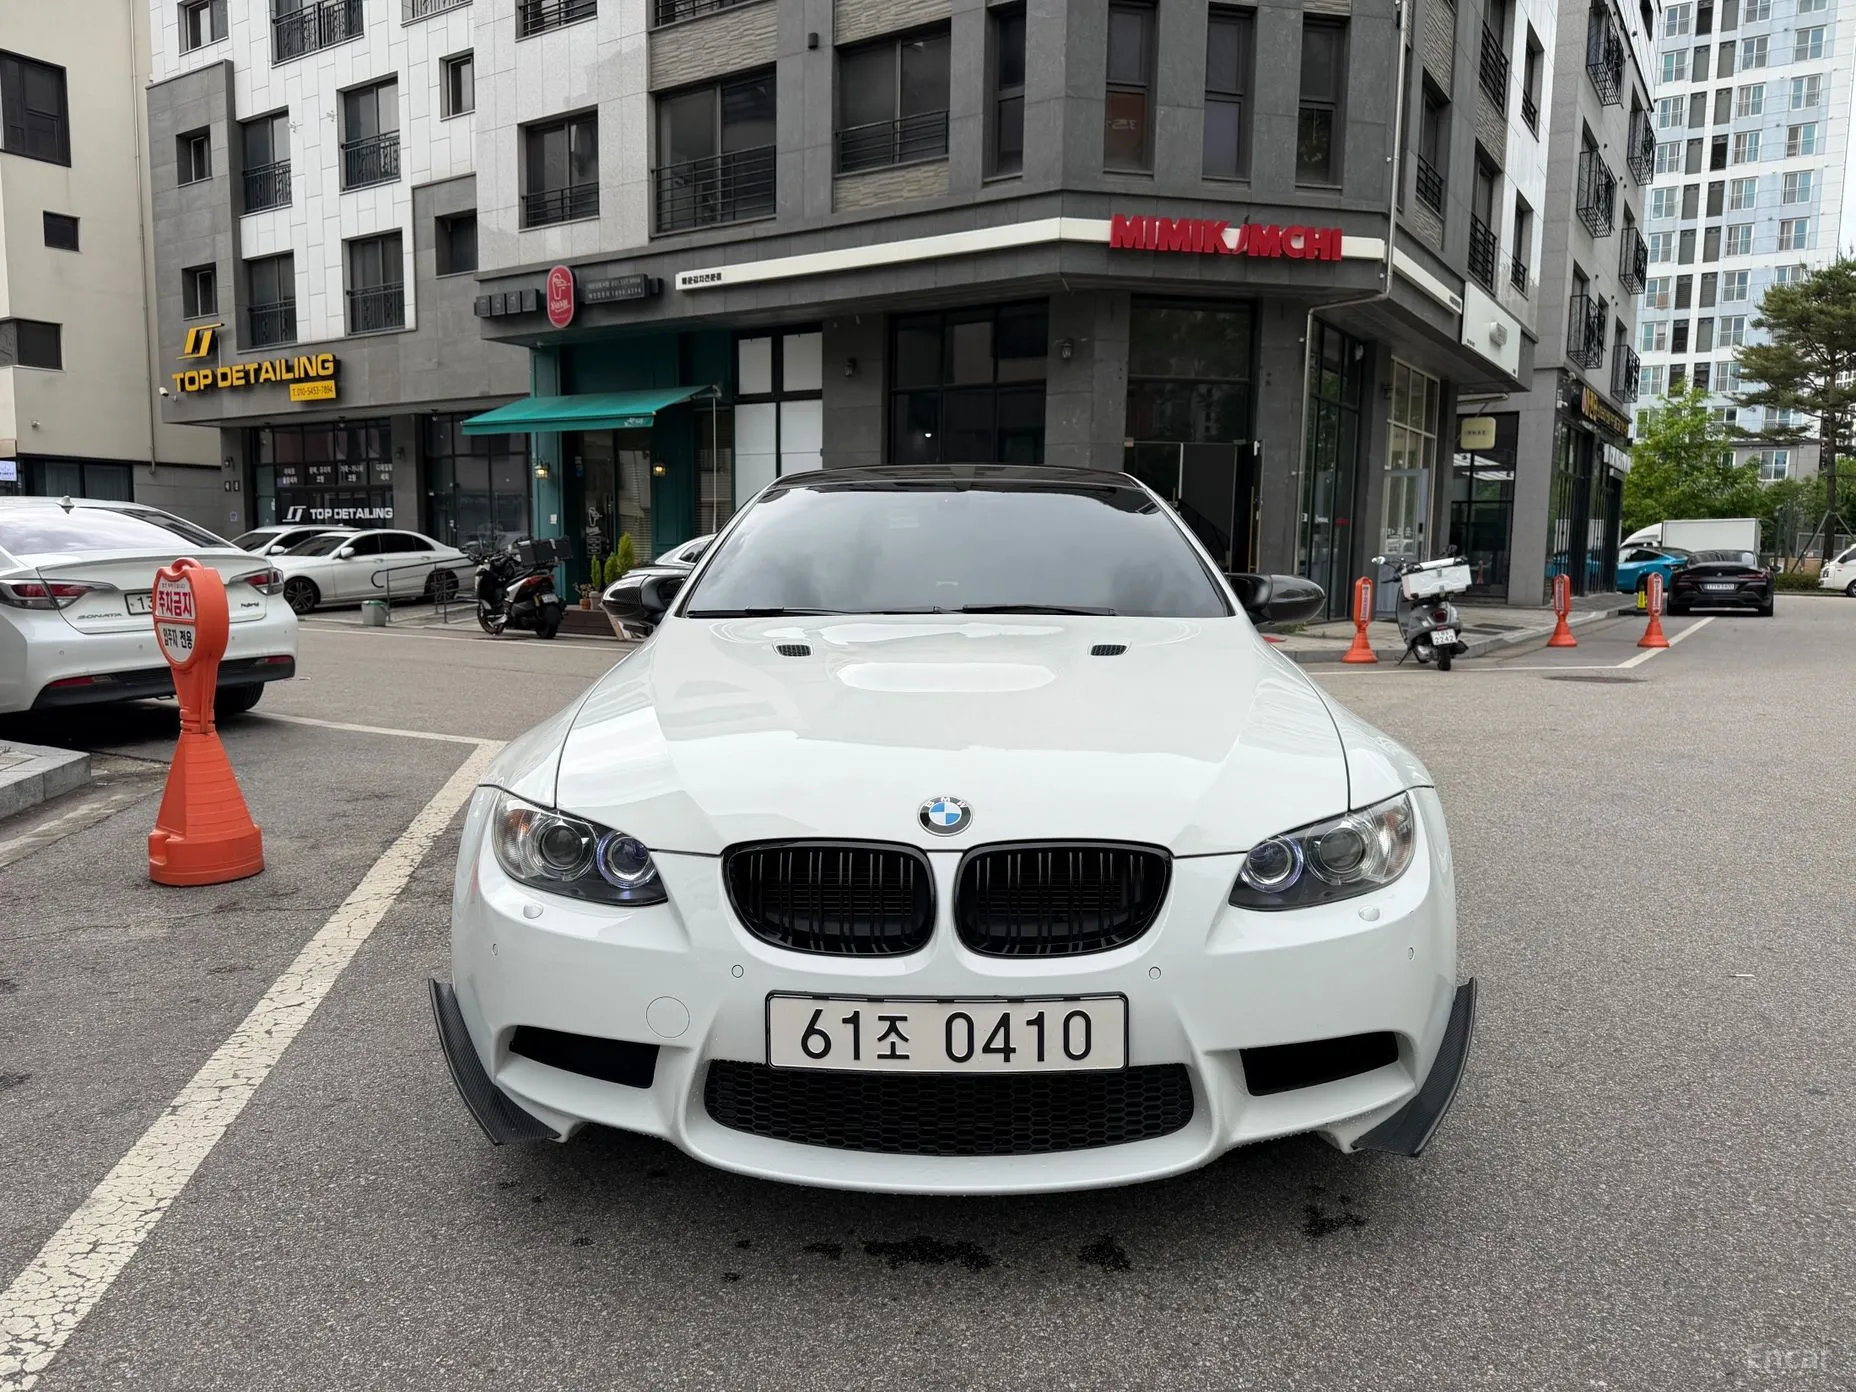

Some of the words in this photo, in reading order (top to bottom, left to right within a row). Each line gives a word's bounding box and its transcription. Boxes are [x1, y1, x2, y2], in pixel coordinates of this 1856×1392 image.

[172, 368, 213, 392] TOP
[217, 353, 335, 388] DETAILING
[310, 508, 332, 520] TOP
[334, 507, 393, 520] DETAILING
[159, 590, 193, 617] 주차금지
[179, 630, 193, 650] 전용
[800, 1008, 911, 1061] 61조
[944, 1009, 1092, 1063] 0410
